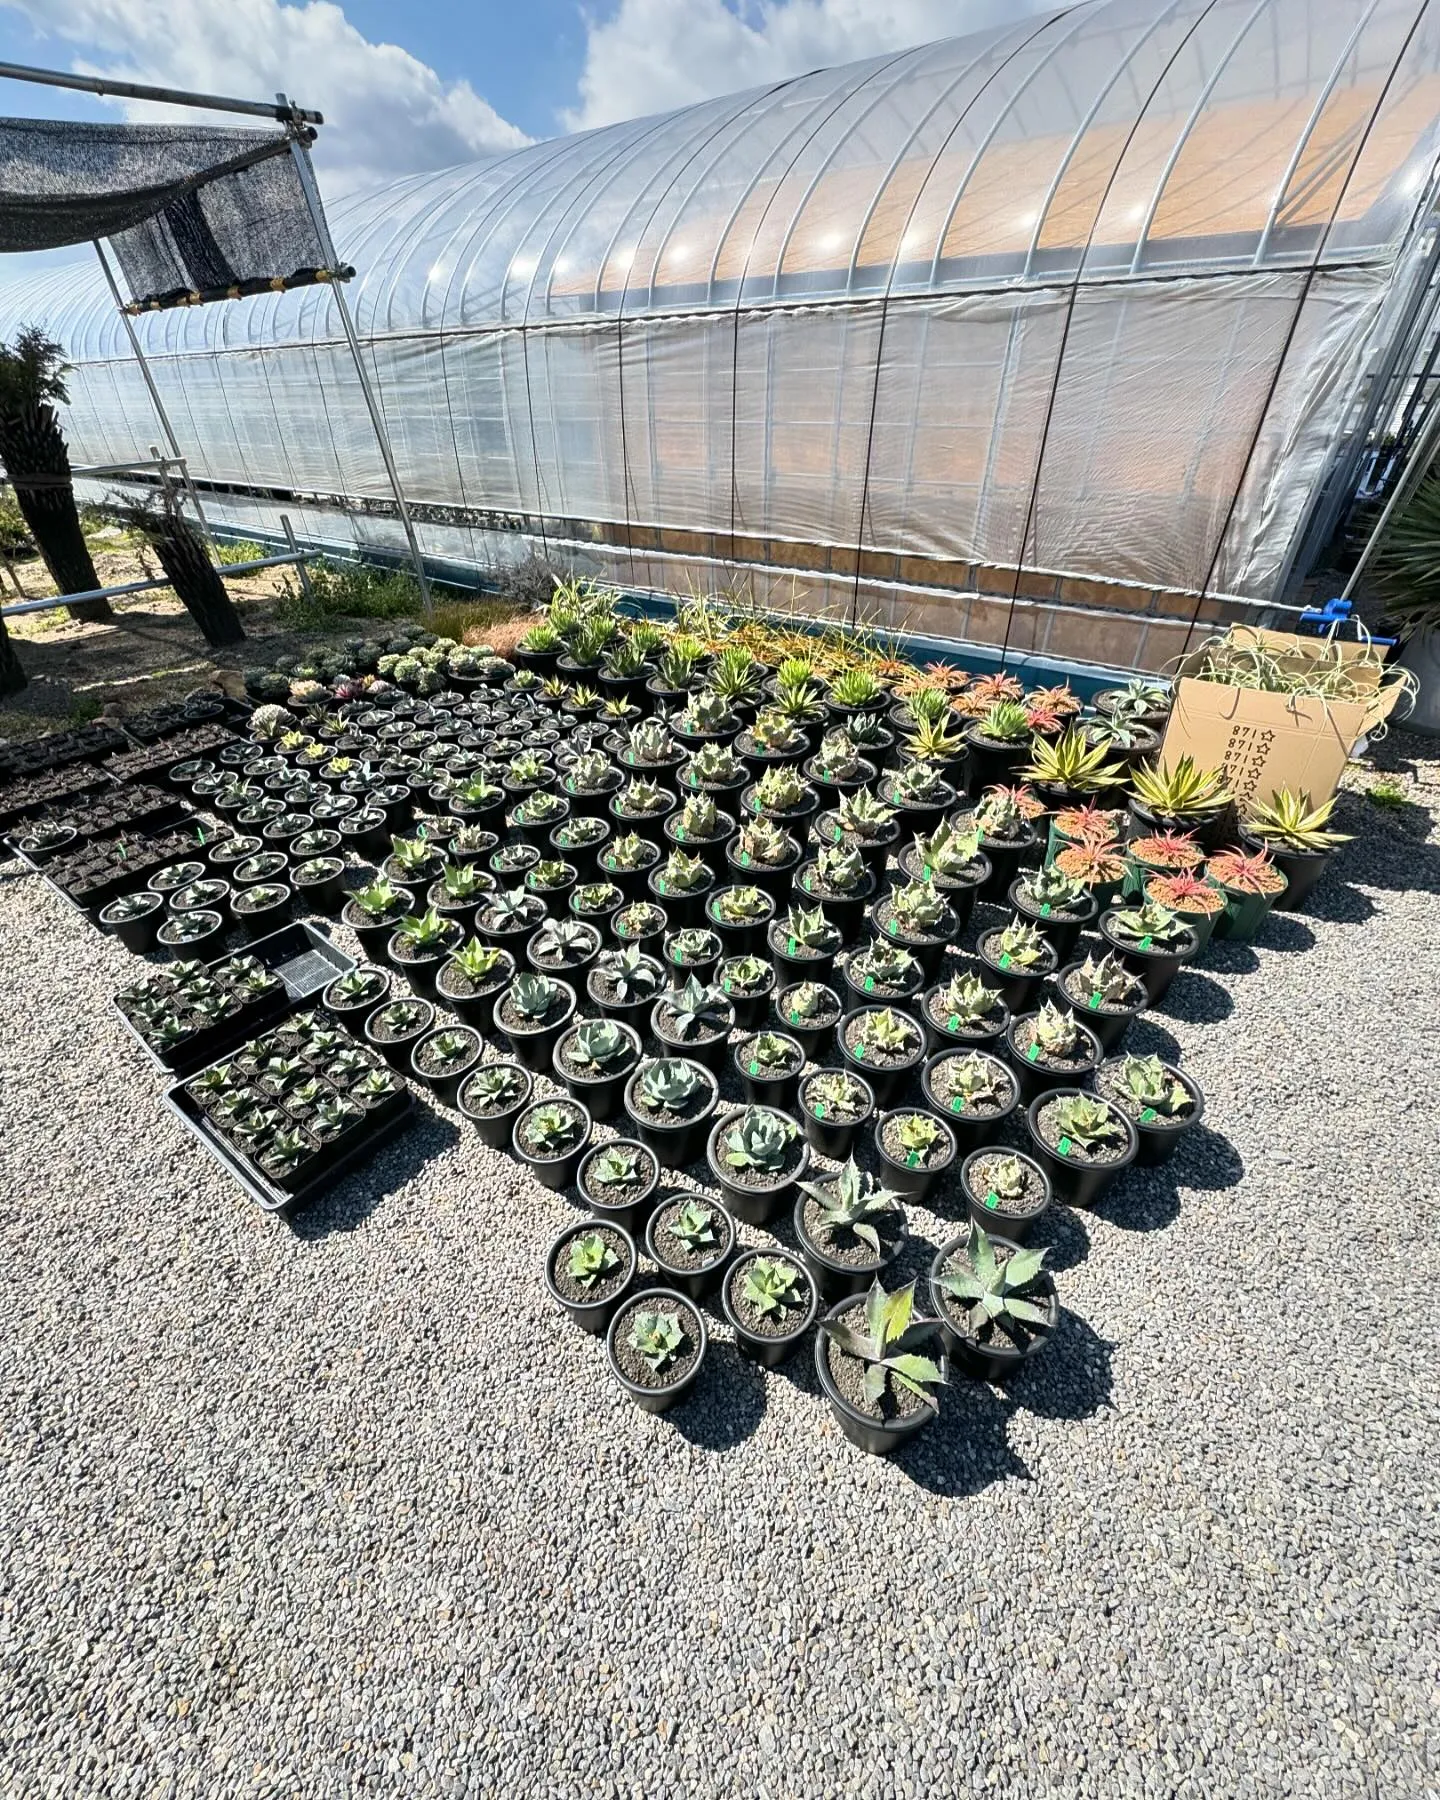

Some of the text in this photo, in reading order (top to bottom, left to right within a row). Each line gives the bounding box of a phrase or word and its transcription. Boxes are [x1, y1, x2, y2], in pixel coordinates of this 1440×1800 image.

[1232, 725, 1257, 739] 871
[1228, 738, 1252, 751] 871
[1224, 750, 1248, 763] 871
